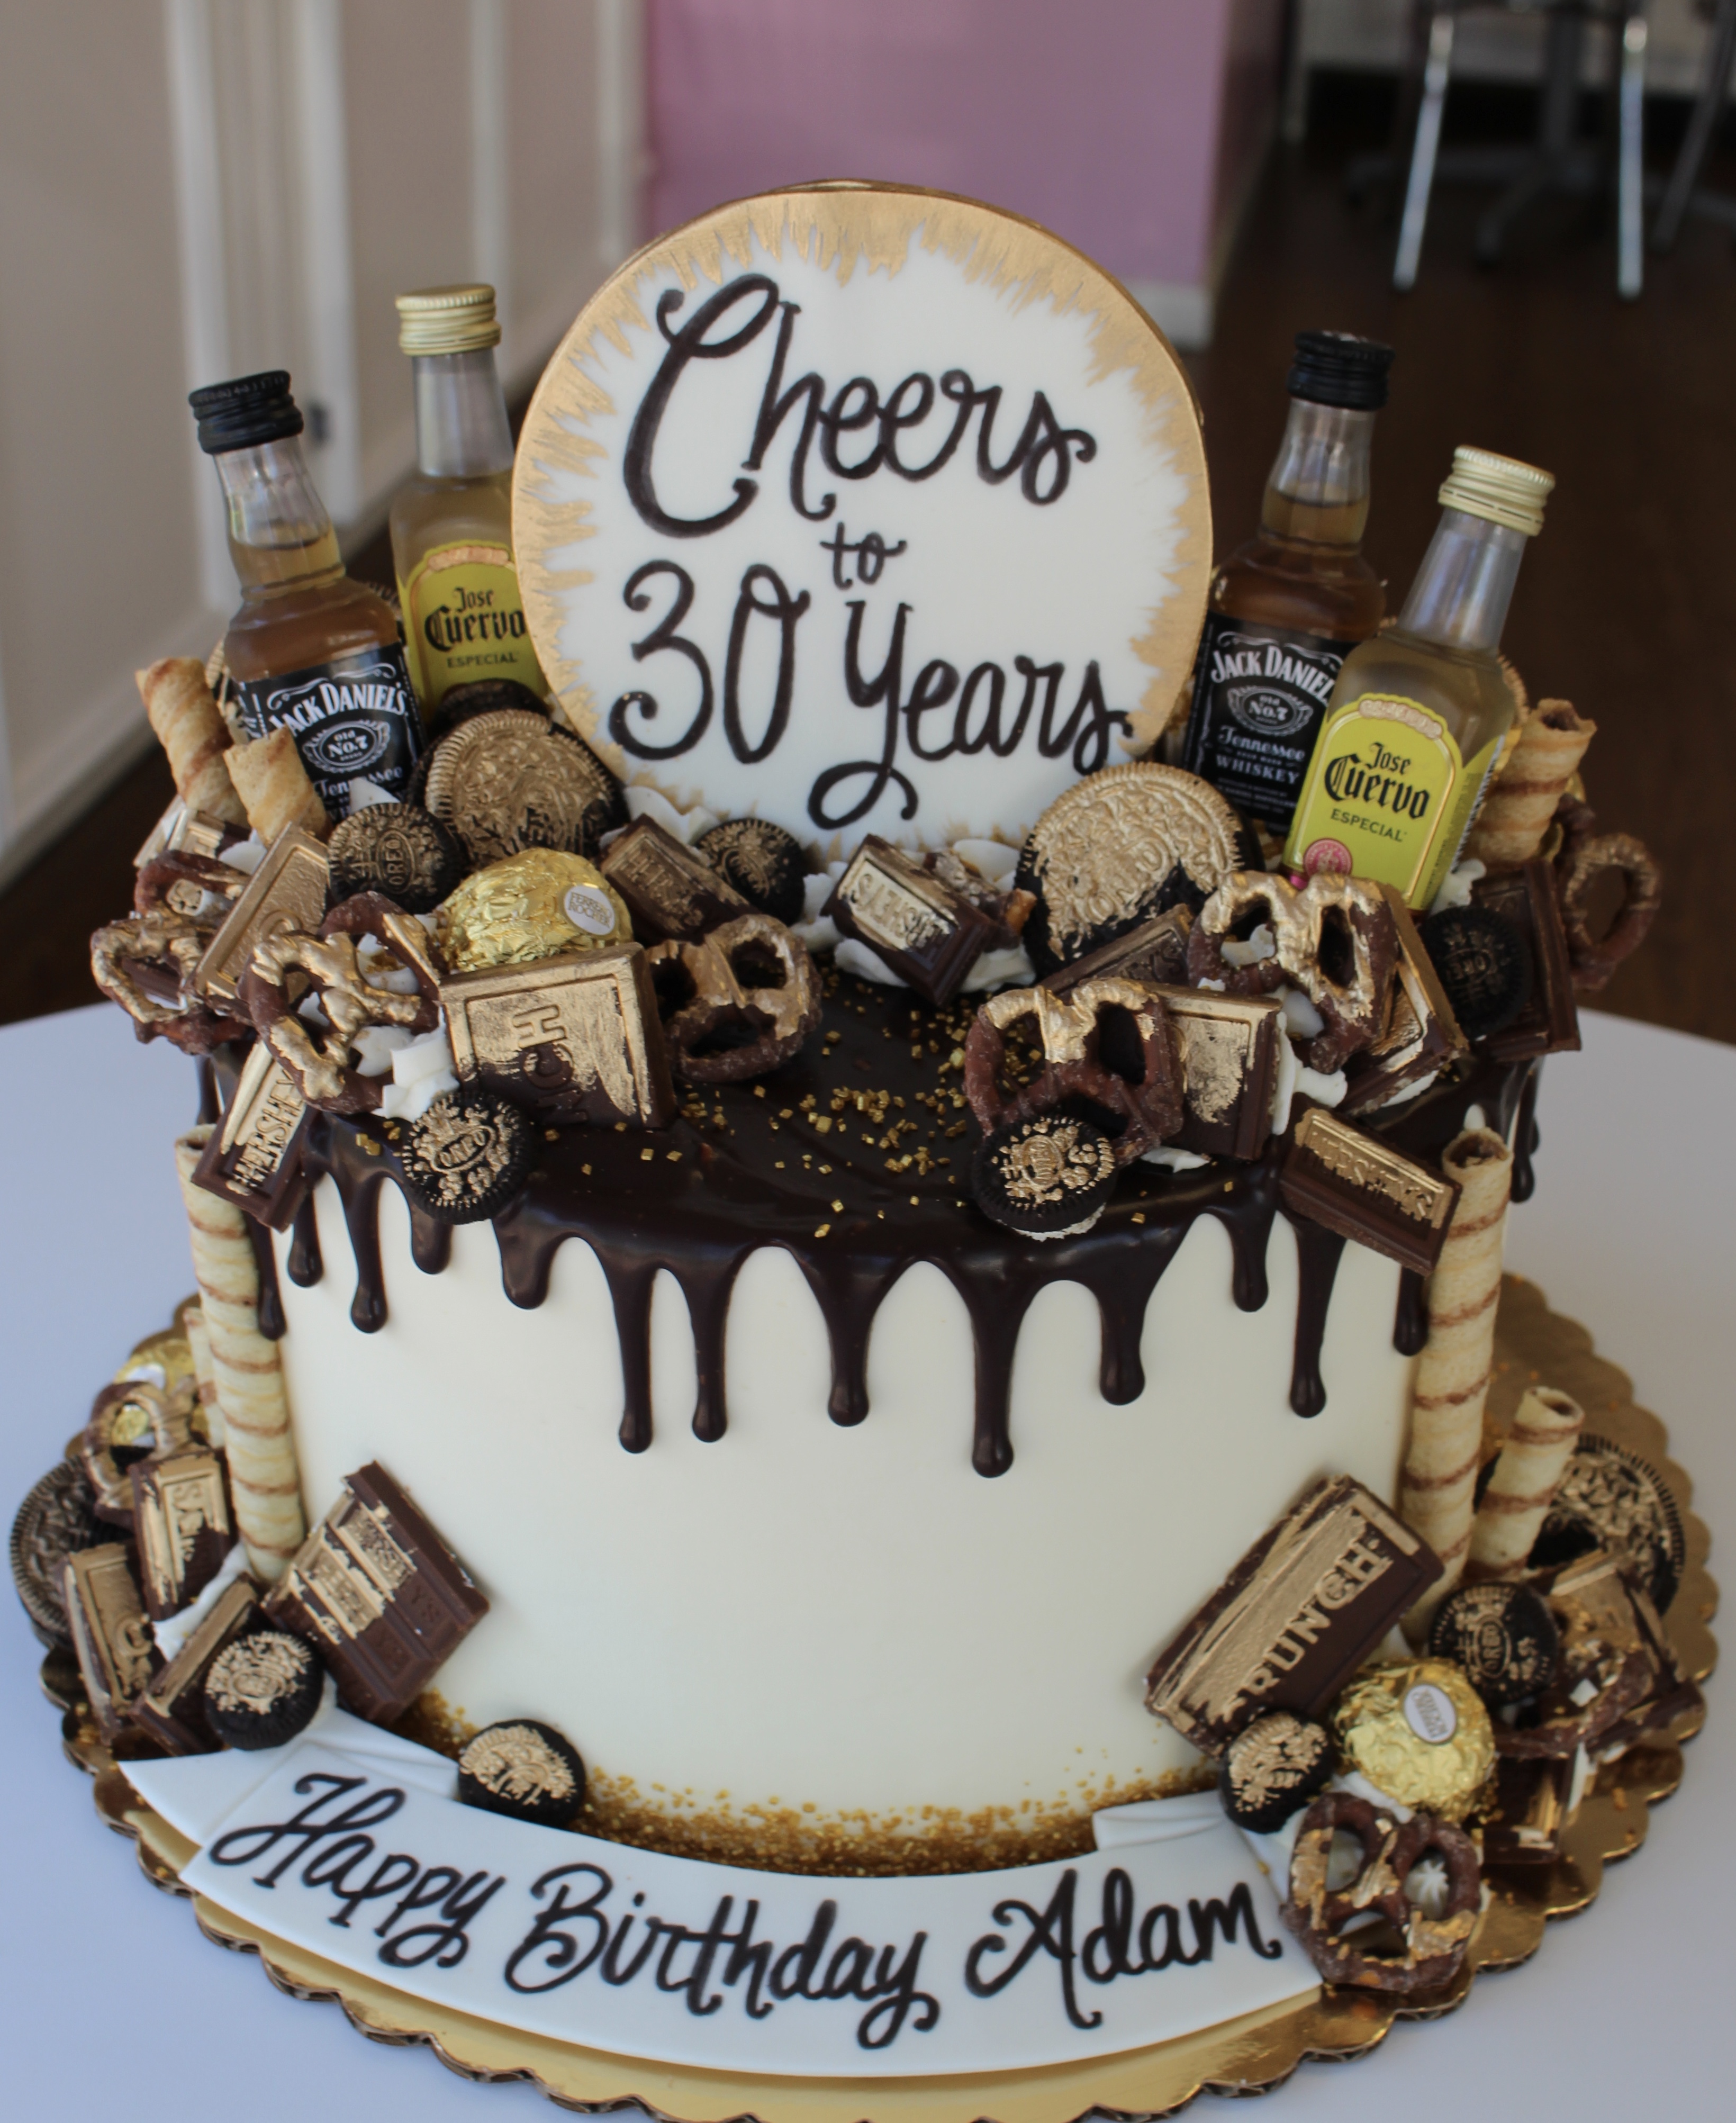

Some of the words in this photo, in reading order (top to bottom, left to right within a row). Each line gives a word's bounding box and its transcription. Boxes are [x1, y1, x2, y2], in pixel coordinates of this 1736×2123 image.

[623, 273, 1098, 539] Cheers
[819, 521, 908, 591] to
[453, 586, 494, 613] Jose
[423, 604, 528, 653] Cuervo
[446, 652, 517, 668] ESPECIAL
[607, 559, 812, 764] 30
[1210, 650, 1263, 683] JACK
[1264, 645, 1335, 704] DANIEL
[319, 681, 408, 716] DANIEL'S
[1217, 724, 1306, 762] Tennessee
[1364, 742, 1412, 775] Jose
[314, 766, 404, 796] Tenssee
[1215, 754, 1300, 785] WHISKEY
[1324, 753, 1431, 820] Cuervo
[1330, 808, 1403, 843] ESPECIAL
[384, 838, 406, 886] OREO
[438, 1128, 486, 1168] OREO
[208, 1771, 507, 1969] Happy
[503, 1861, 941, 2050] Birthday
[964, 1867, 1283, 2030] Adam
